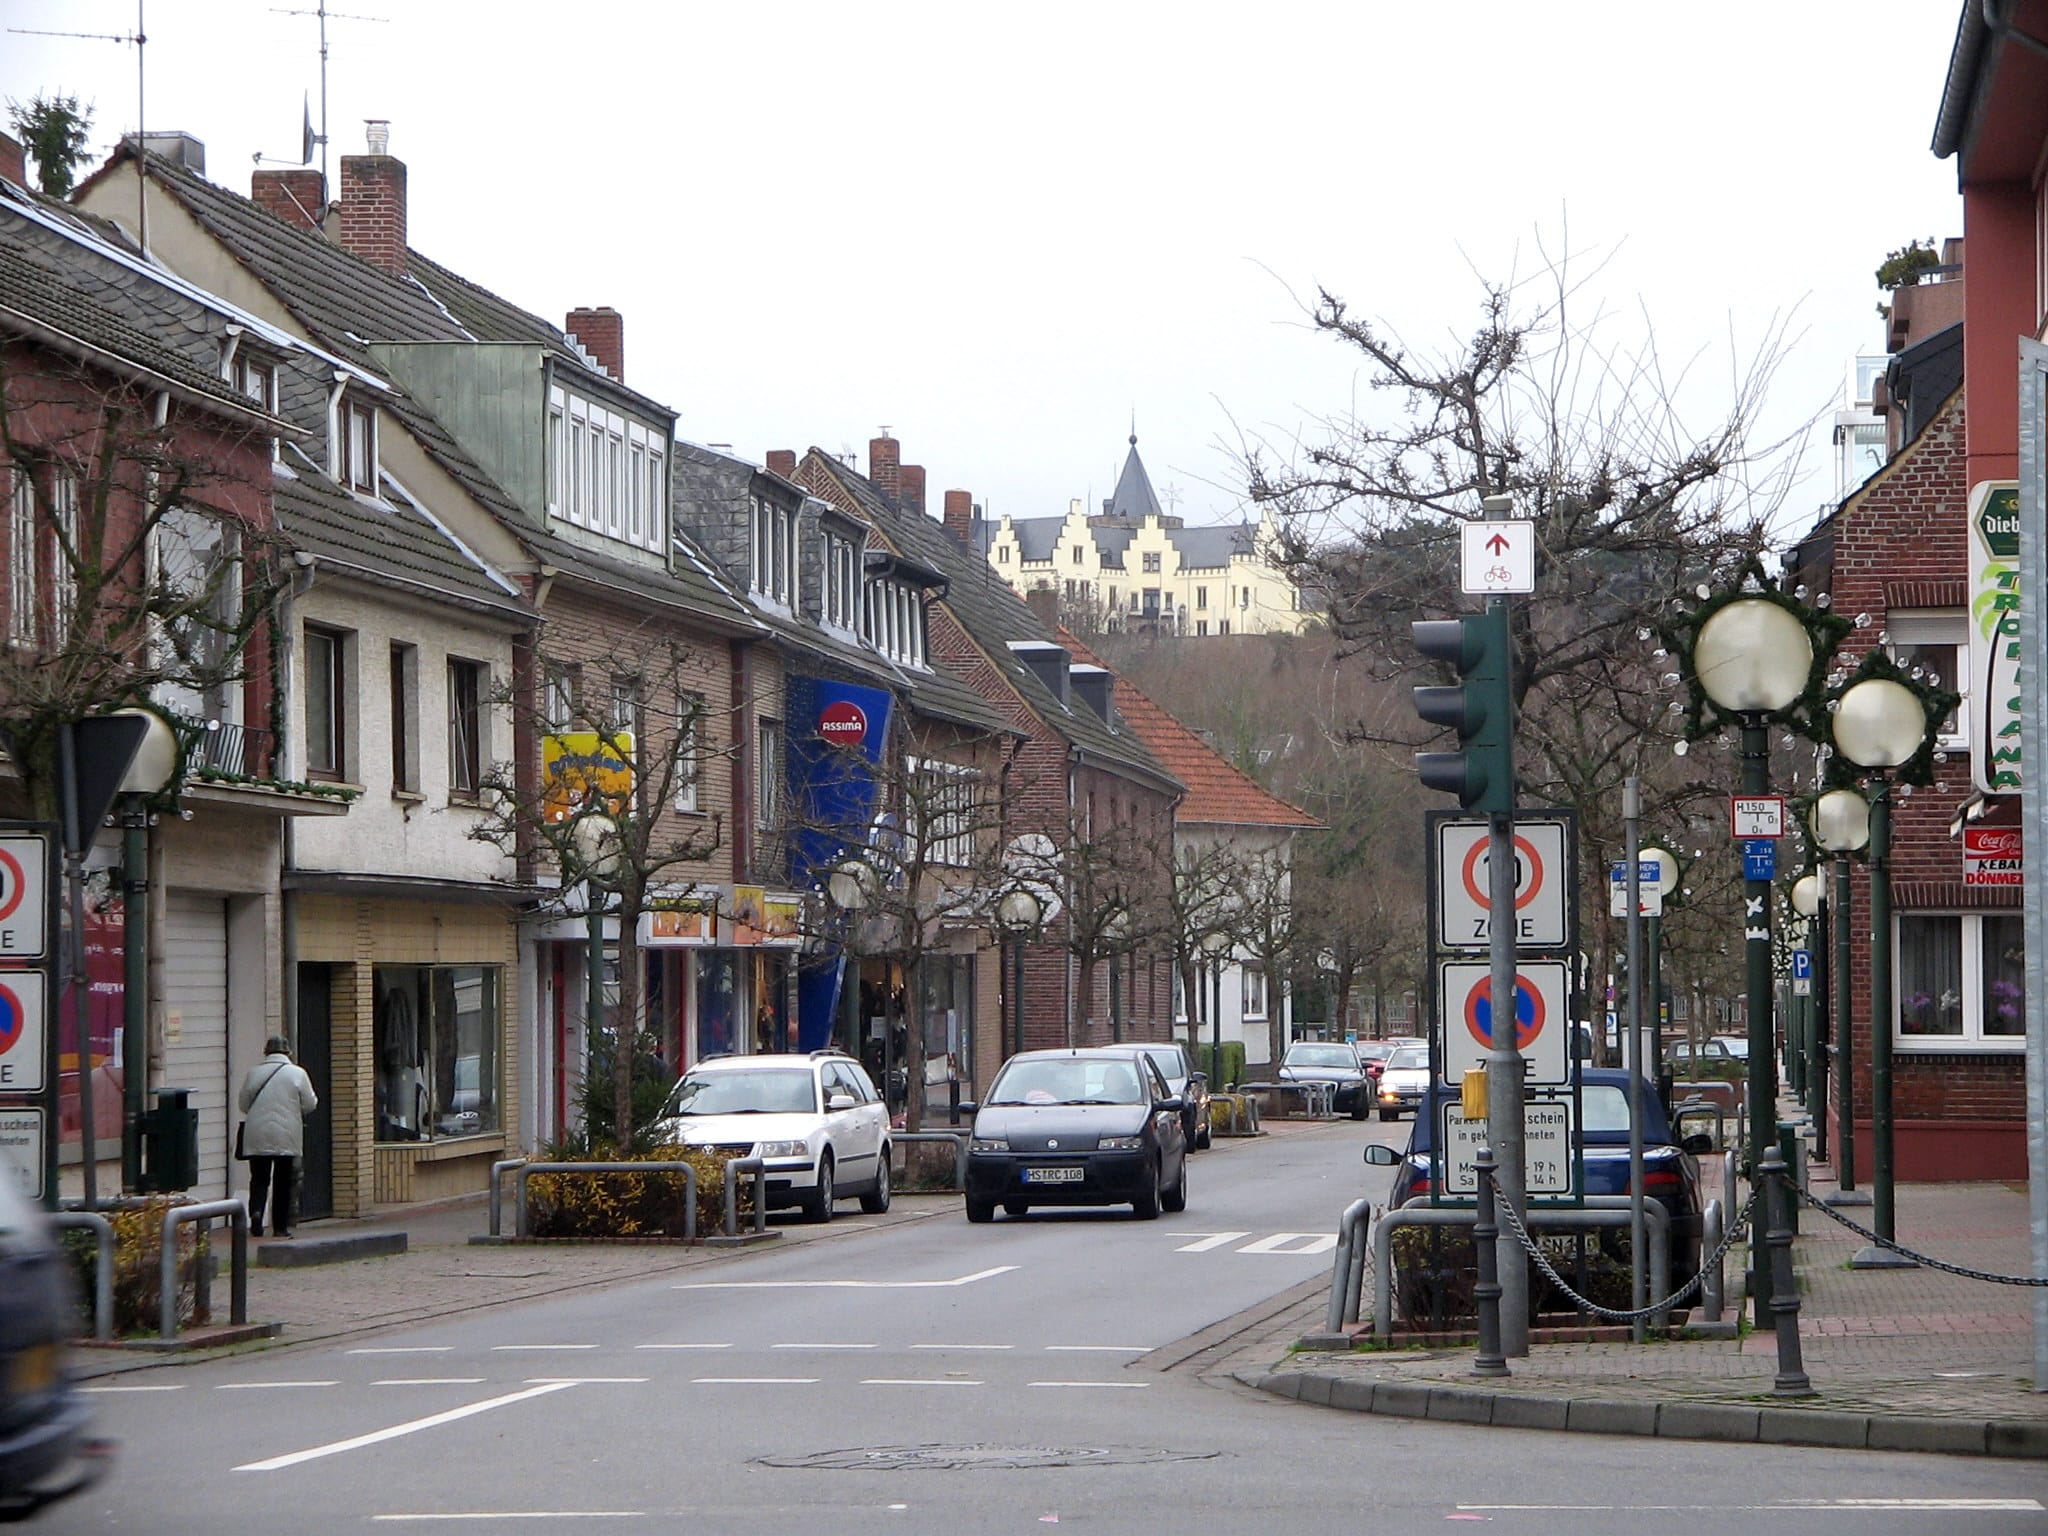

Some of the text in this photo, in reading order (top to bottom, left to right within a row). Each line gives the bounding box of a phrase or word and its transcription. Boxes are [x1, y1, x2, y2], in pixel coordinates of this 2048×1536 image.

[822, 721, 862, 731] ASSIMA
[1473, 918, 1535, 938] ZE
[1797, 954, 1808, 977] P
[1533, 1161, 1545, 1172] 19
[1549, 1161, 1556, 1172] h
[1460, 1174, 1556, 1185] Sa 14 h
